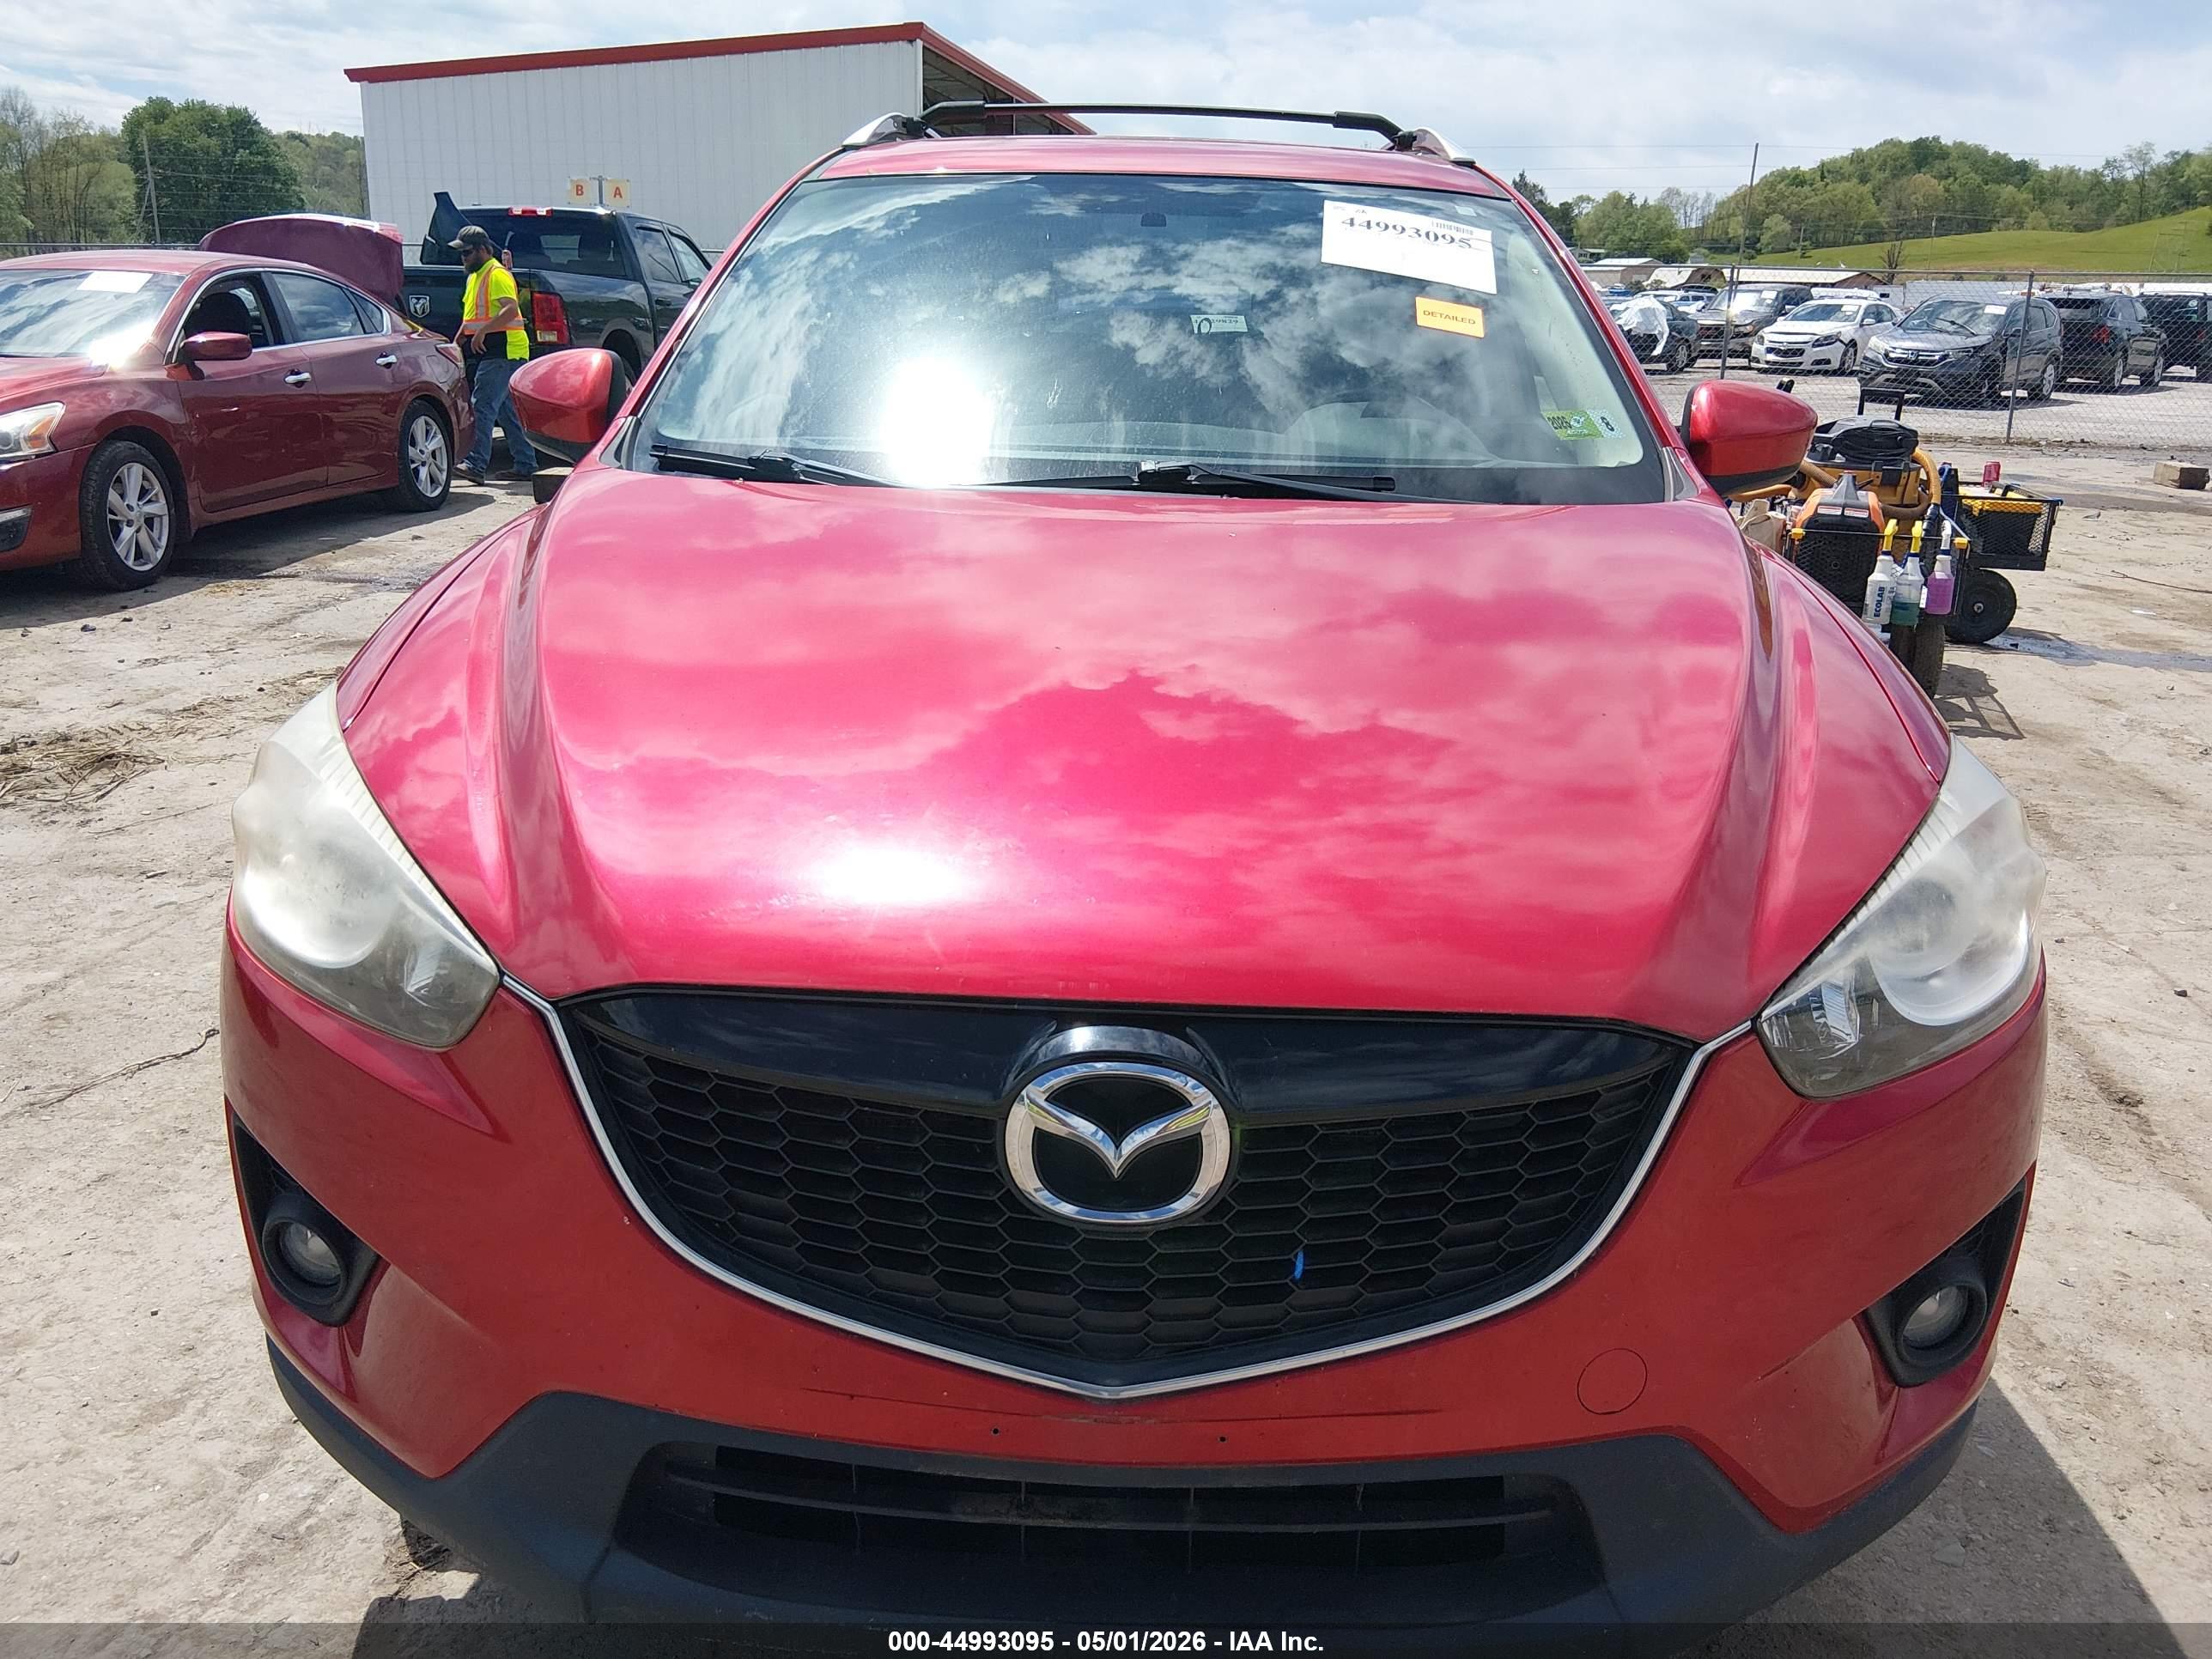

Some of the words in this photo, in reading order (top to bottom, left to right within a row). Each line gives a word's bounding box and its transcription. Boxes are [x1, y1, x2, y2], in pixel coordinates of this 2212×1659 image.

[575, 185, 584, 196] B
[613, 186, 623, 198] A
[1341, 216, 1473, 249] 44993095
[1422, 309, 1476, 325] DETAILED
[1600, 416, 1615, 432] 8
[1874, 586, 1886, 617] ECOLAB
